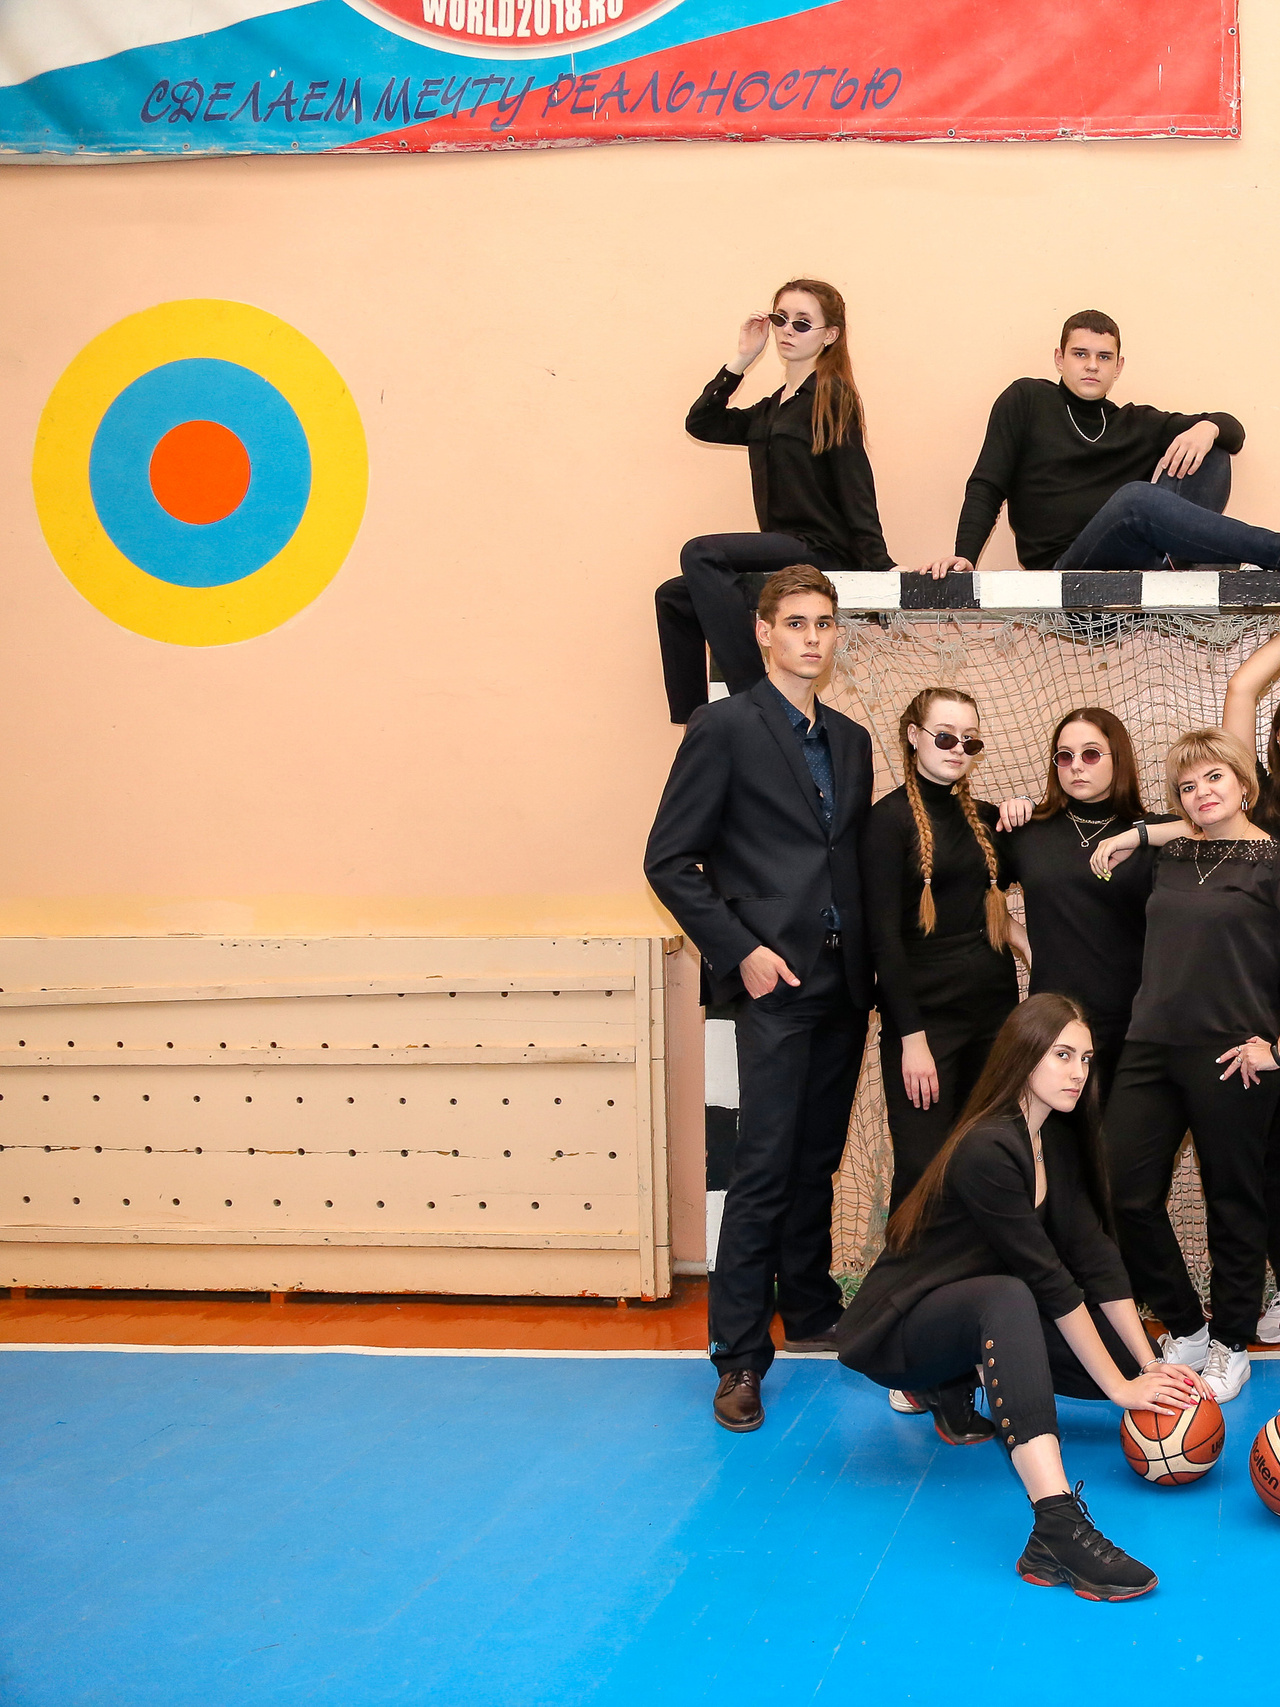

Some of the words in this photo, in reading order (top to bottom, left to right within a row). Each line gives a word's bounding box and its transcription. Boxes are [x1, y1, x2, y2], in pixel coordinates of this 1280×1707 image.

[421, 0, 625, 37] WORLD2018.RU
[140, 77, 362, 125] СДЕЛАЕМ
[372, 73, 537, 132] МЕЧТУ
[541, 65, 903, 118] РЕАЛЬНОСТЬЮ
